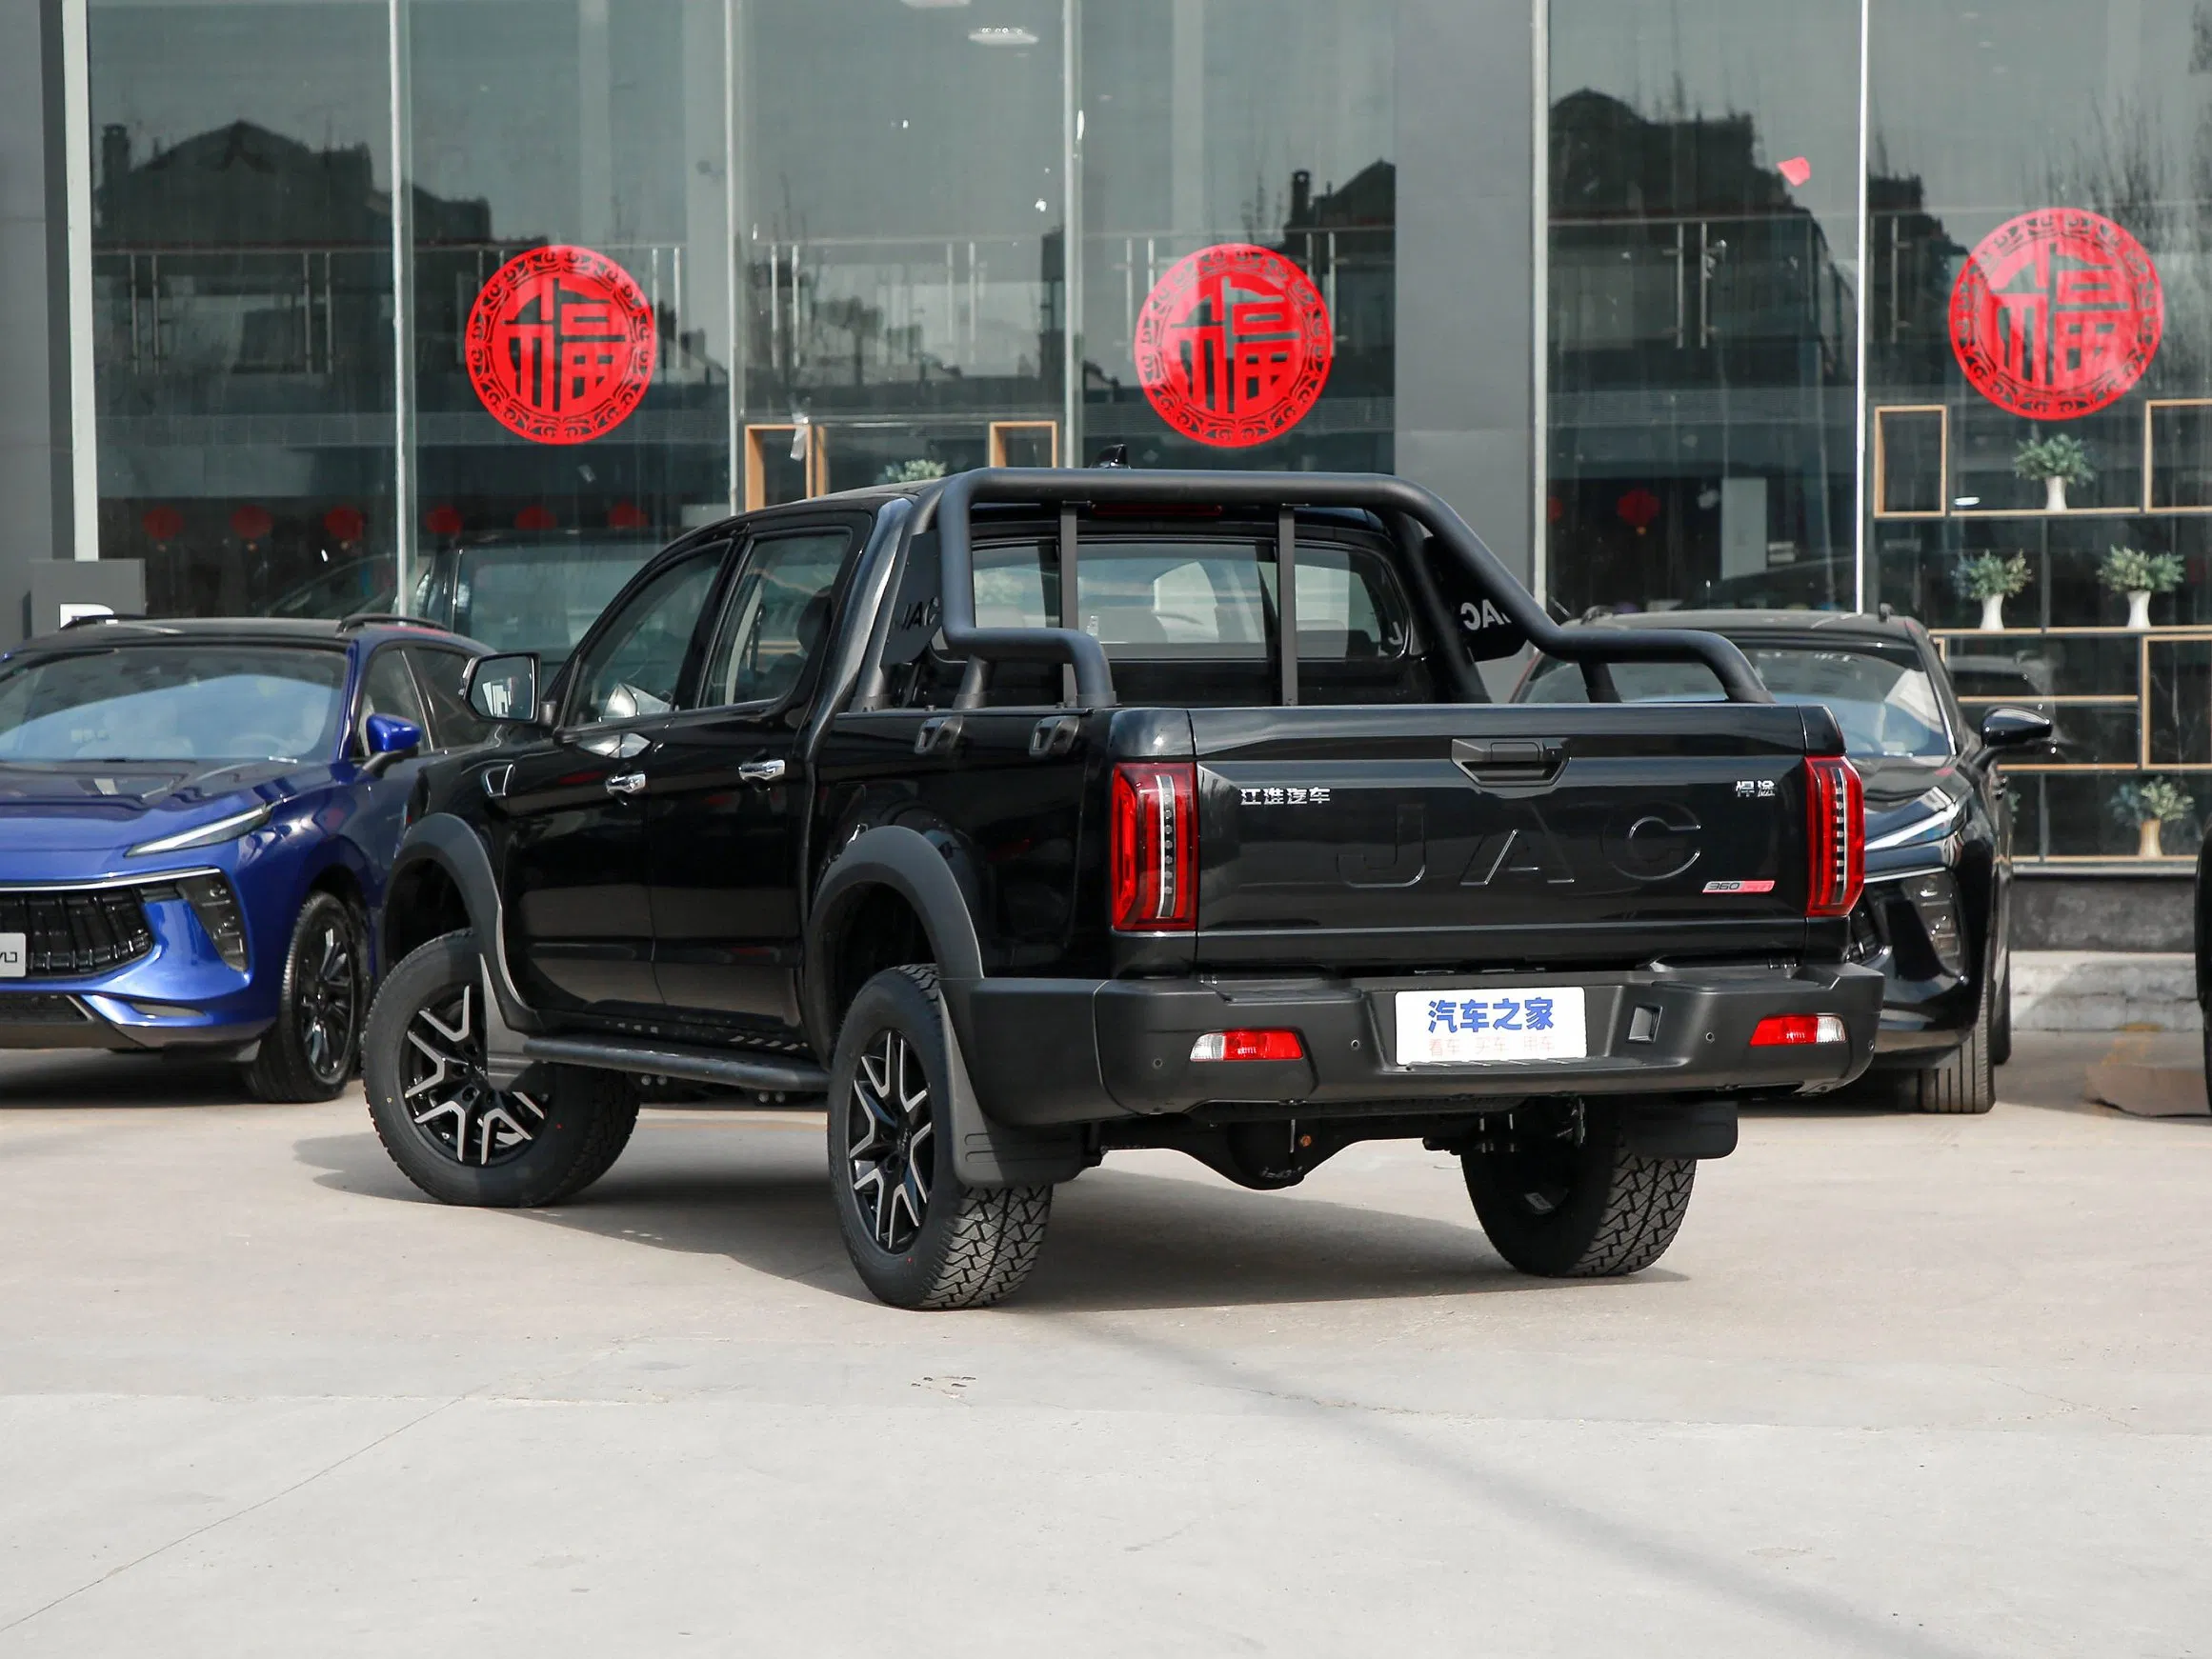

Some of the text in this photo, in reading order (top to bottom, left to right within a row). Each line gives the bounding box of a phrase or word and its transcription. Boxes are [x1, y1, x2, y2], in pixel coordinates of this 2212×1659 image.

[503, 277, 625, 411] 福
[1170, 275, 1300, 413] 福
[1988, 242, 2129, 386] 福
[1240, 787, 1331, 806] 江淮汽车
[1337, 800, 1701, 888] JAC
[1428, 997, 1554, 1033] 汽车之家
